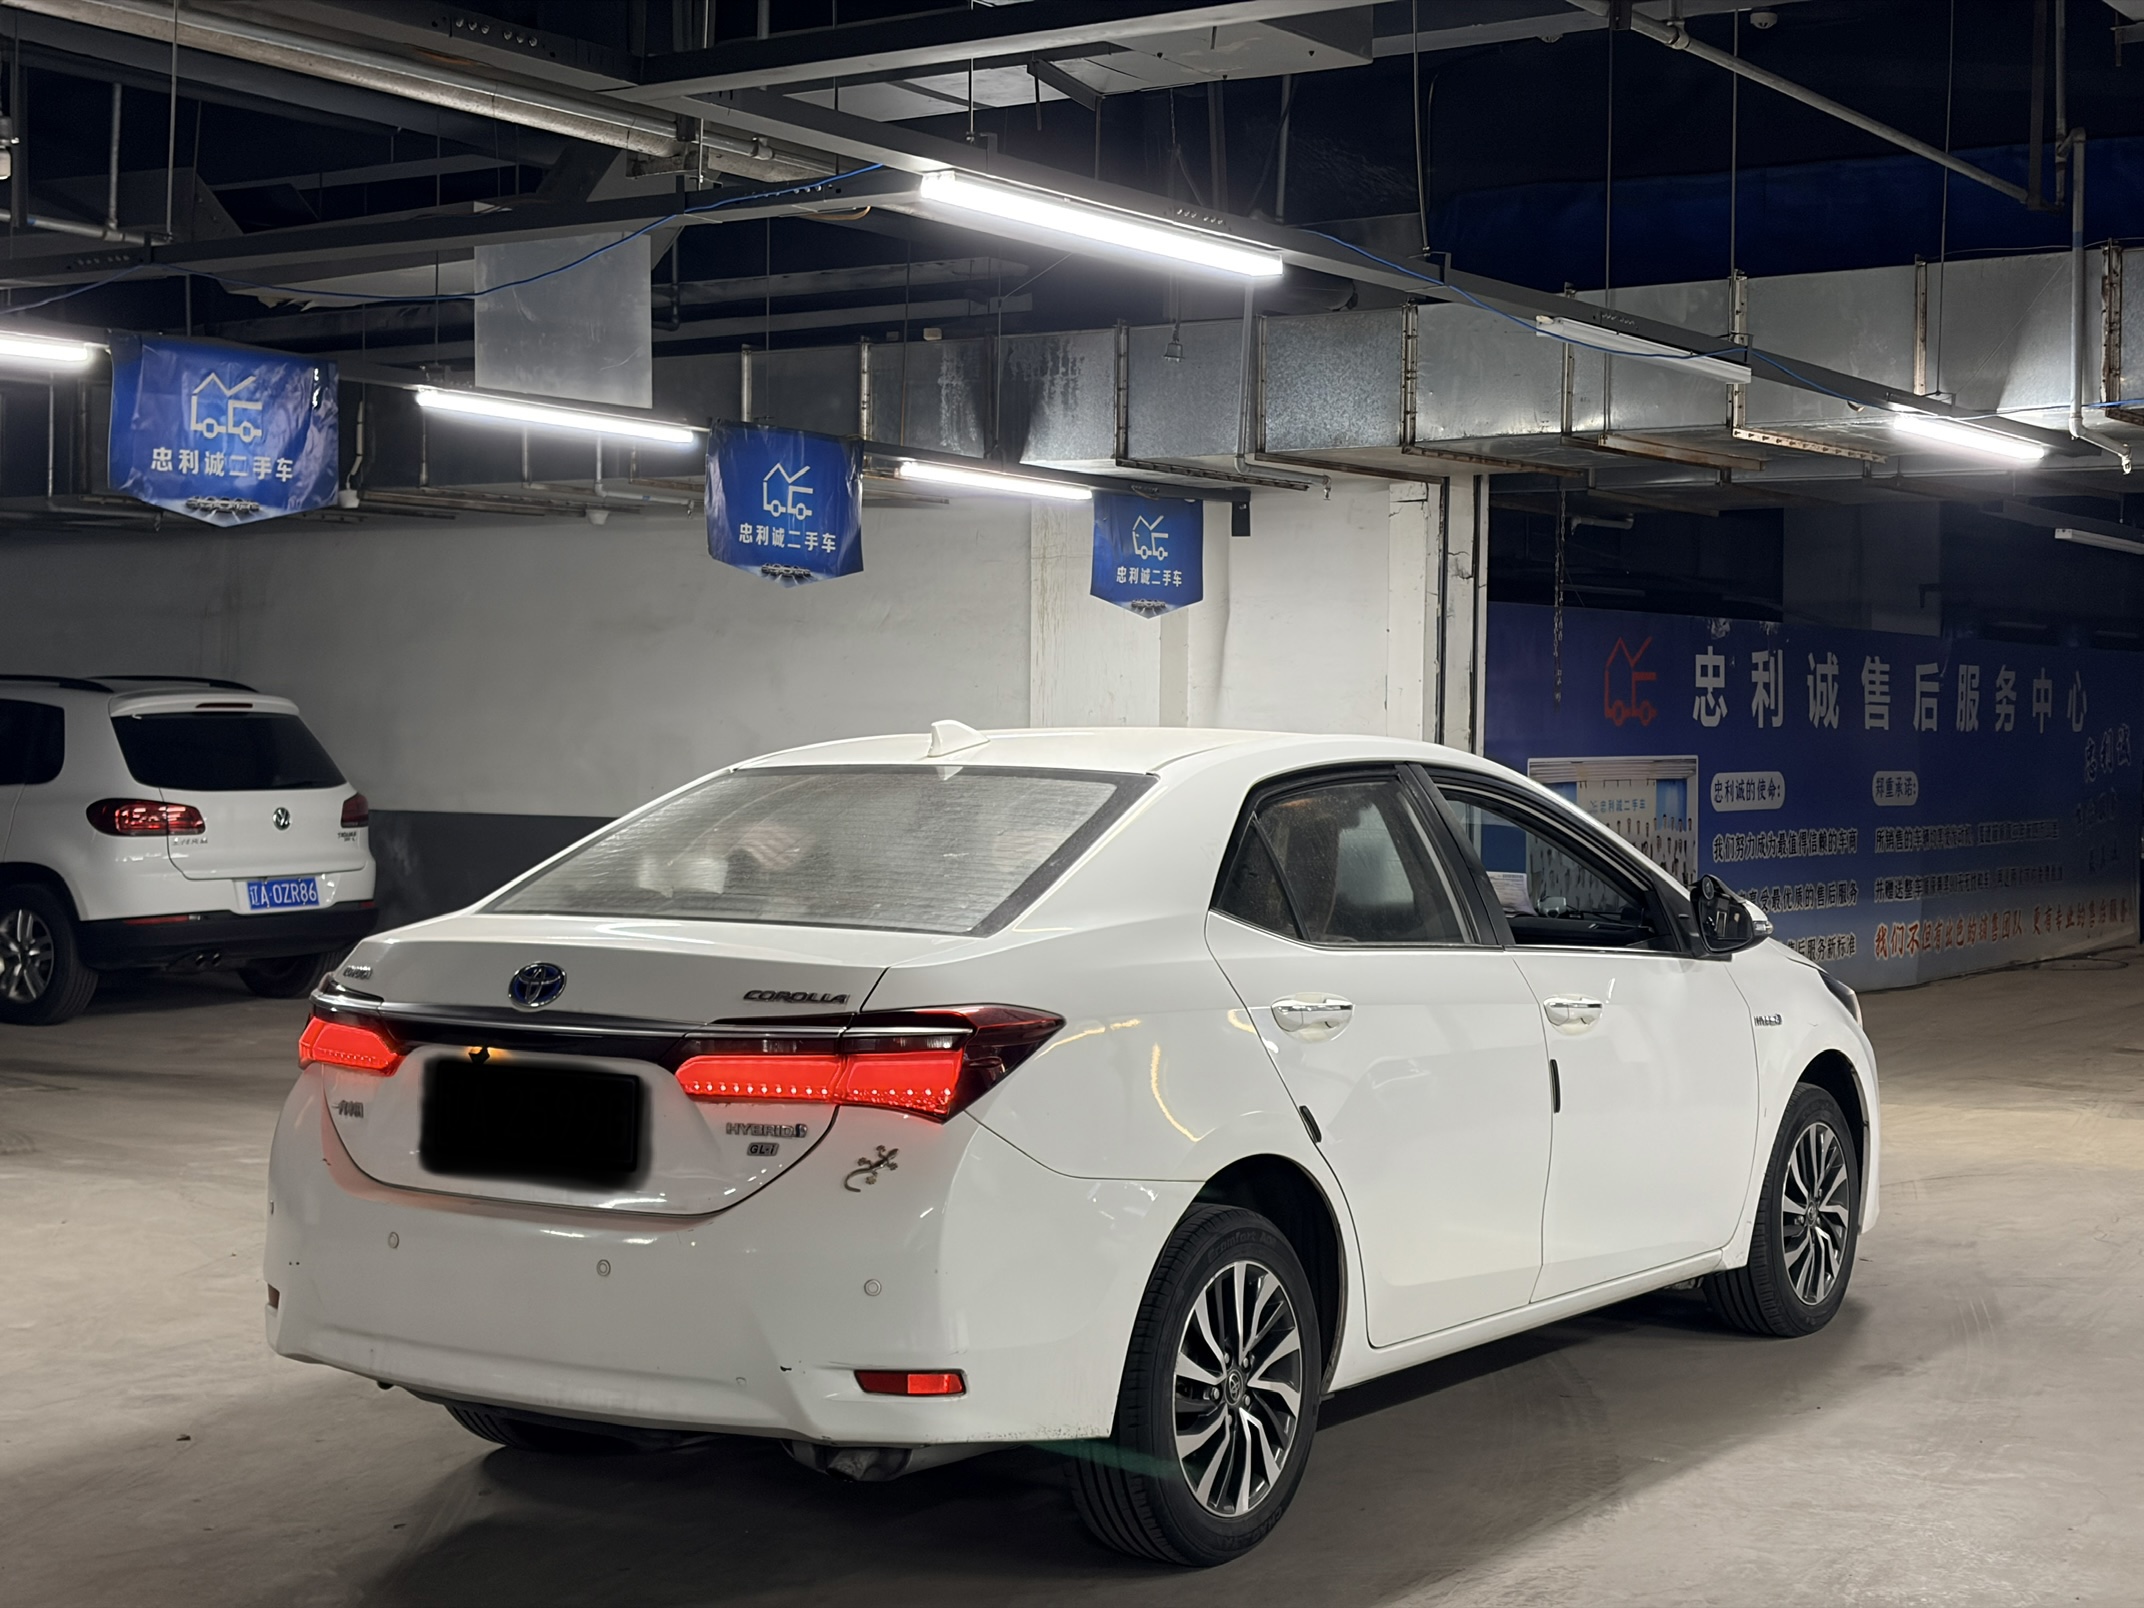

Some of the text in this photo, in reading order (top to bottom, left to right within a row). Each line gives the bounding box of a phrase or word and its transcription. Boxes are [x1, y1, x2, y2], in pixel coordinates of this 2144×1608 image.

[151, 447, 293, 482] 忠利诚二手车
[739, 523, 836, 553] 忠利诚二手车
[1116, 566, 1182, 587] 忠利诚二手车
[1692, 645, 2088, 735] 忠利诚售后服务中心
[1713, 828, 1858, 863] 我们努力成为最值得信赖的车商
[743, 989, 848, 1005] COROLLA
[726, 1122, 795, 1139] HYBRID
